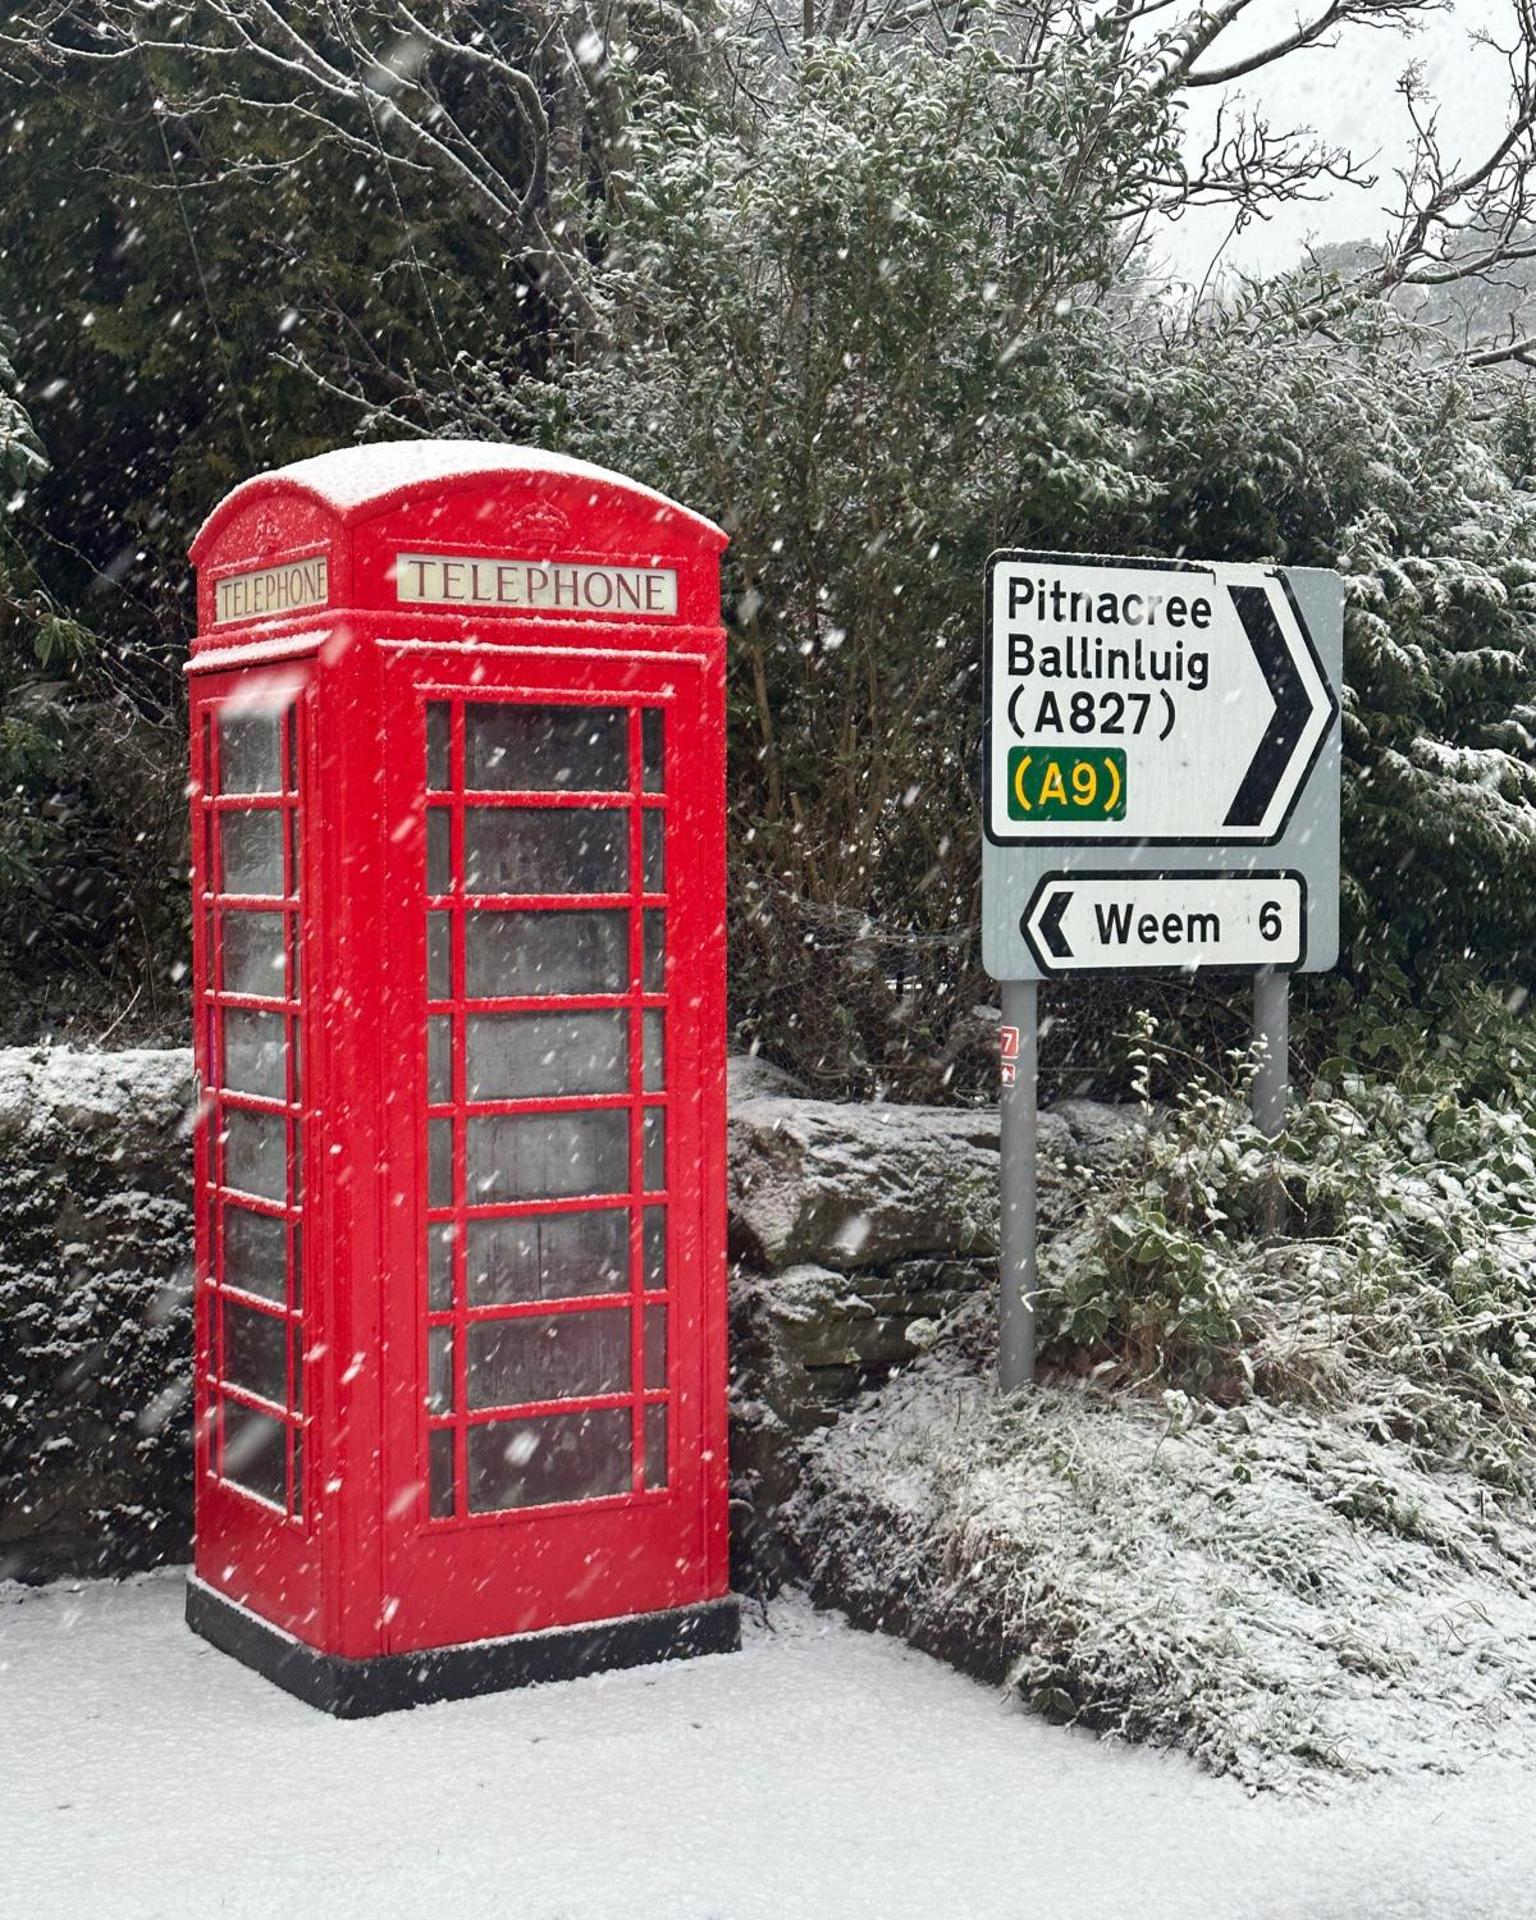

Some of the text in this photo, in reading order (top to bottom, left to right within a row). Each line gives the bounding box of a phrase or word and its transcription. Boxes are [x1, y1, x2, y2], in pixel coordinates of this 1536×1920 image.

[221, 562, 327, 618] TELEPHONE
[408, 560, 665, 611] TELEPHONE
[1008, 576, 1212, 629] Pitnacree
[1008, 633, 1209, 691] Ballinluig
[1007, 684, 1176, 741] (A827)
[1014, 755, 1121, 812] (A9)
[1094, 901, 1282, 944] Weem 6
[1003, 1032, 1013, 1053] 7
